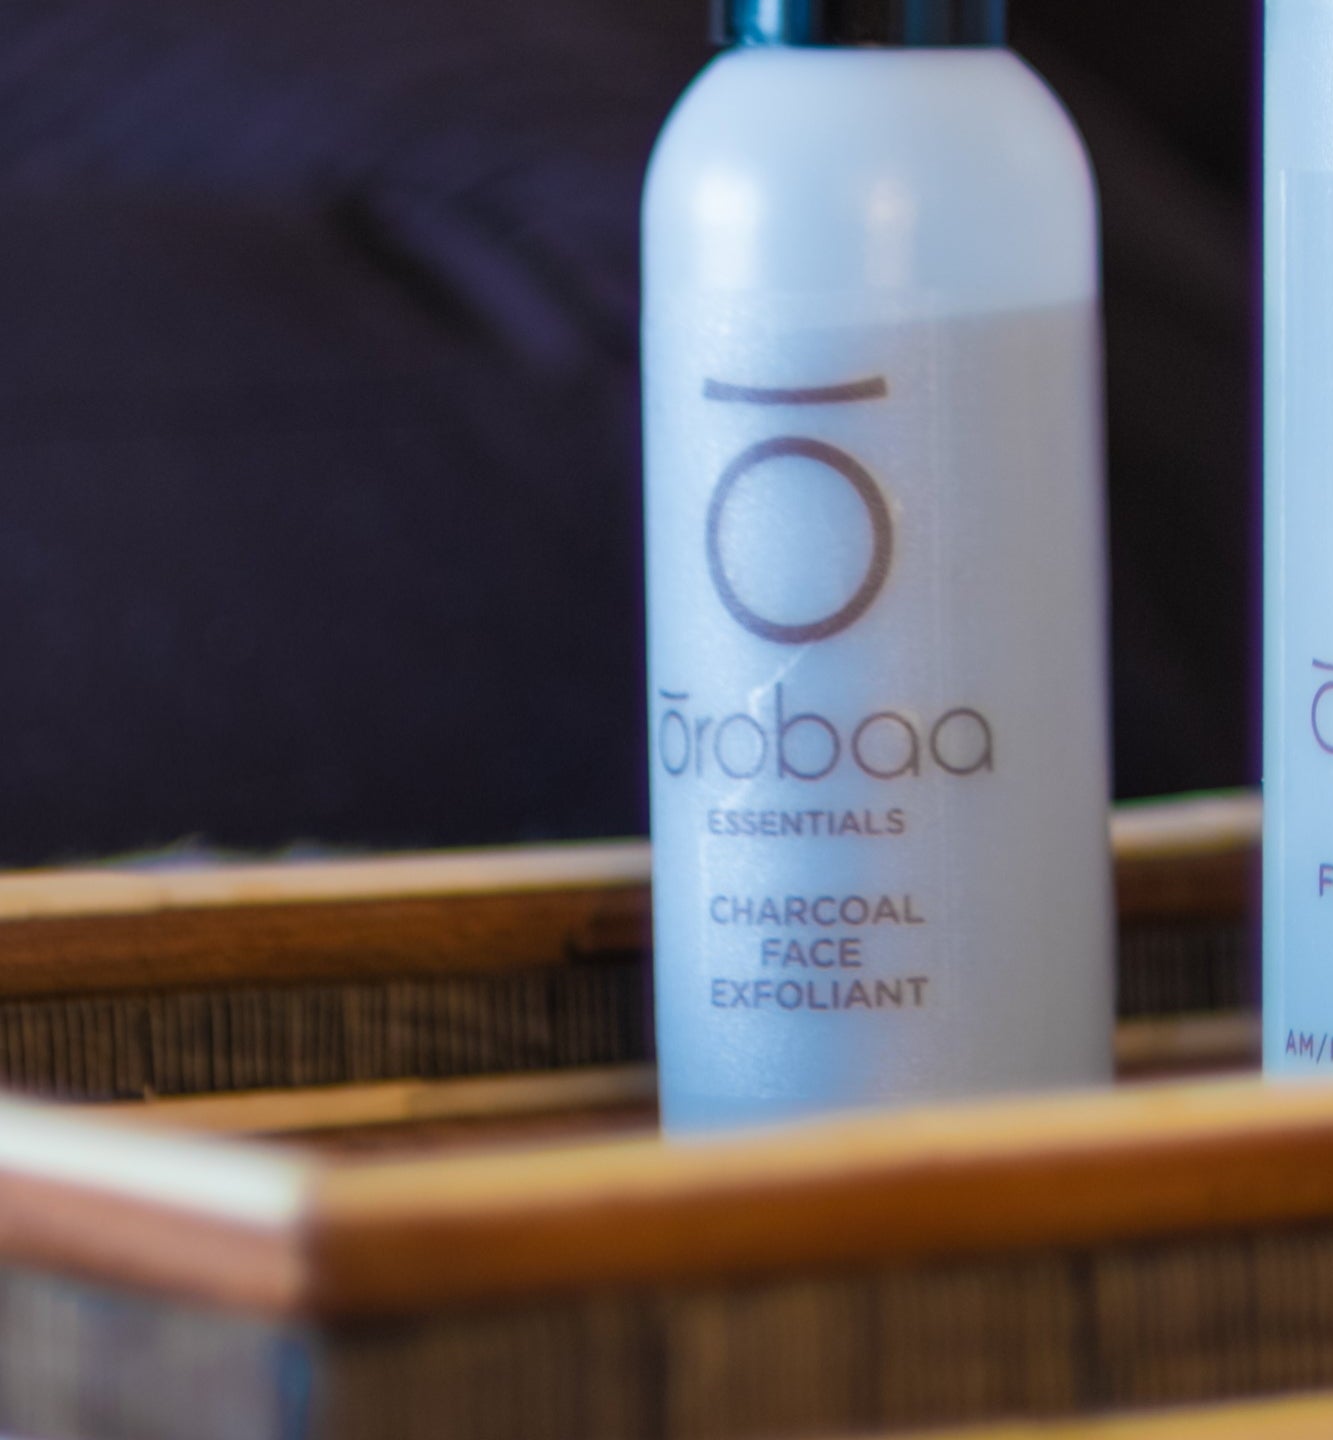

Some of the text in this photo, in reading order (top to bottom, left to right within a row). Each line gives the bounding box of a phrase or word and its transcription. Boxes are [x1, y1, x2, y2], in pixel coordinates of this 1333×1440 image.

[706, 807, 906, 837] ESSENTIALS
[710, 895, 926, 927] CHARCOAL
[762, 937, 863, 969] FACE
[710, 976, 929, 1011] EXFOLIANT
